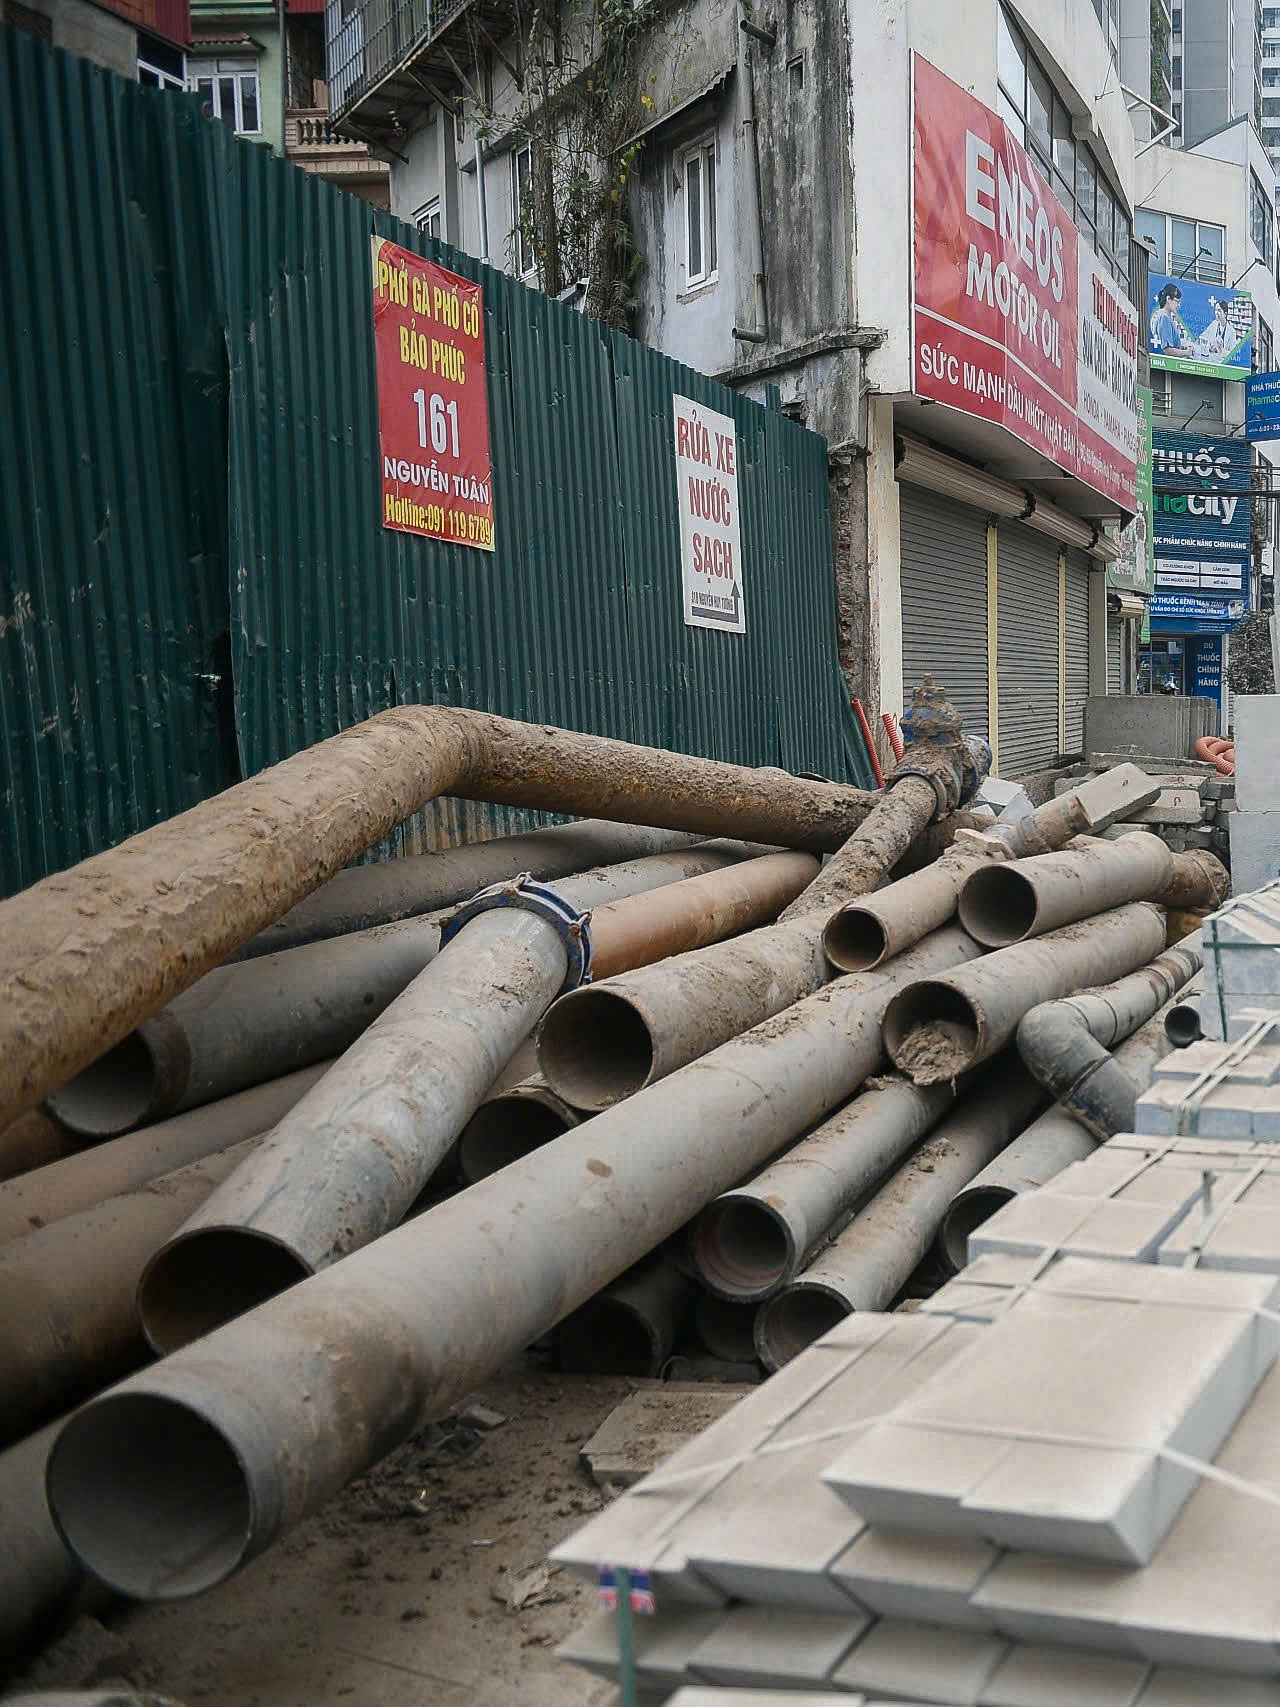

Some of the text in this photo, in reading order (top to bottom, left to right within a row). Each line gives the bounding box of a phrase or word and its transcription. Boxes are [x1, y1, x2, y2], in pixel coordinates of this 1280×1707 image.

[965, 130, 1064, 303] ENEOS
[378, 258, 481, 339] PHỞ GÀ PHỐ CỔ
[966, 244, 1062, 369] MOTOR OIL
[400, 317, 466, 385] BẢO PHÚC
[920, 341, 960, 385] SỨC
[963, 364, 1007, 405] MẠNH
[1007, 376, 1024, 419] DẦU
[1025, 397, 1045, 434] NHỚT
[1044, 414, 1062, 448] NHẬT
[1251, 383, 1264, 392] NHÀ
[413, 388, 460, 458] 161
[678, 408, 735, 475] RỬA XE
[384, 455, 489, 504] NGUYỄN TUÂN
[688, 475, 731, 527] NƯỚC
[449, 510, 467, 538] 119
[468, 514, 492, 545] 6789
[693, 533, 734, 584] SẠCH
[1158, 595, 1179, 605] THUỐC
[1197, 652, 1220, 661] THUỐC
[1197, 665, 1220, 673] CHÍNH
